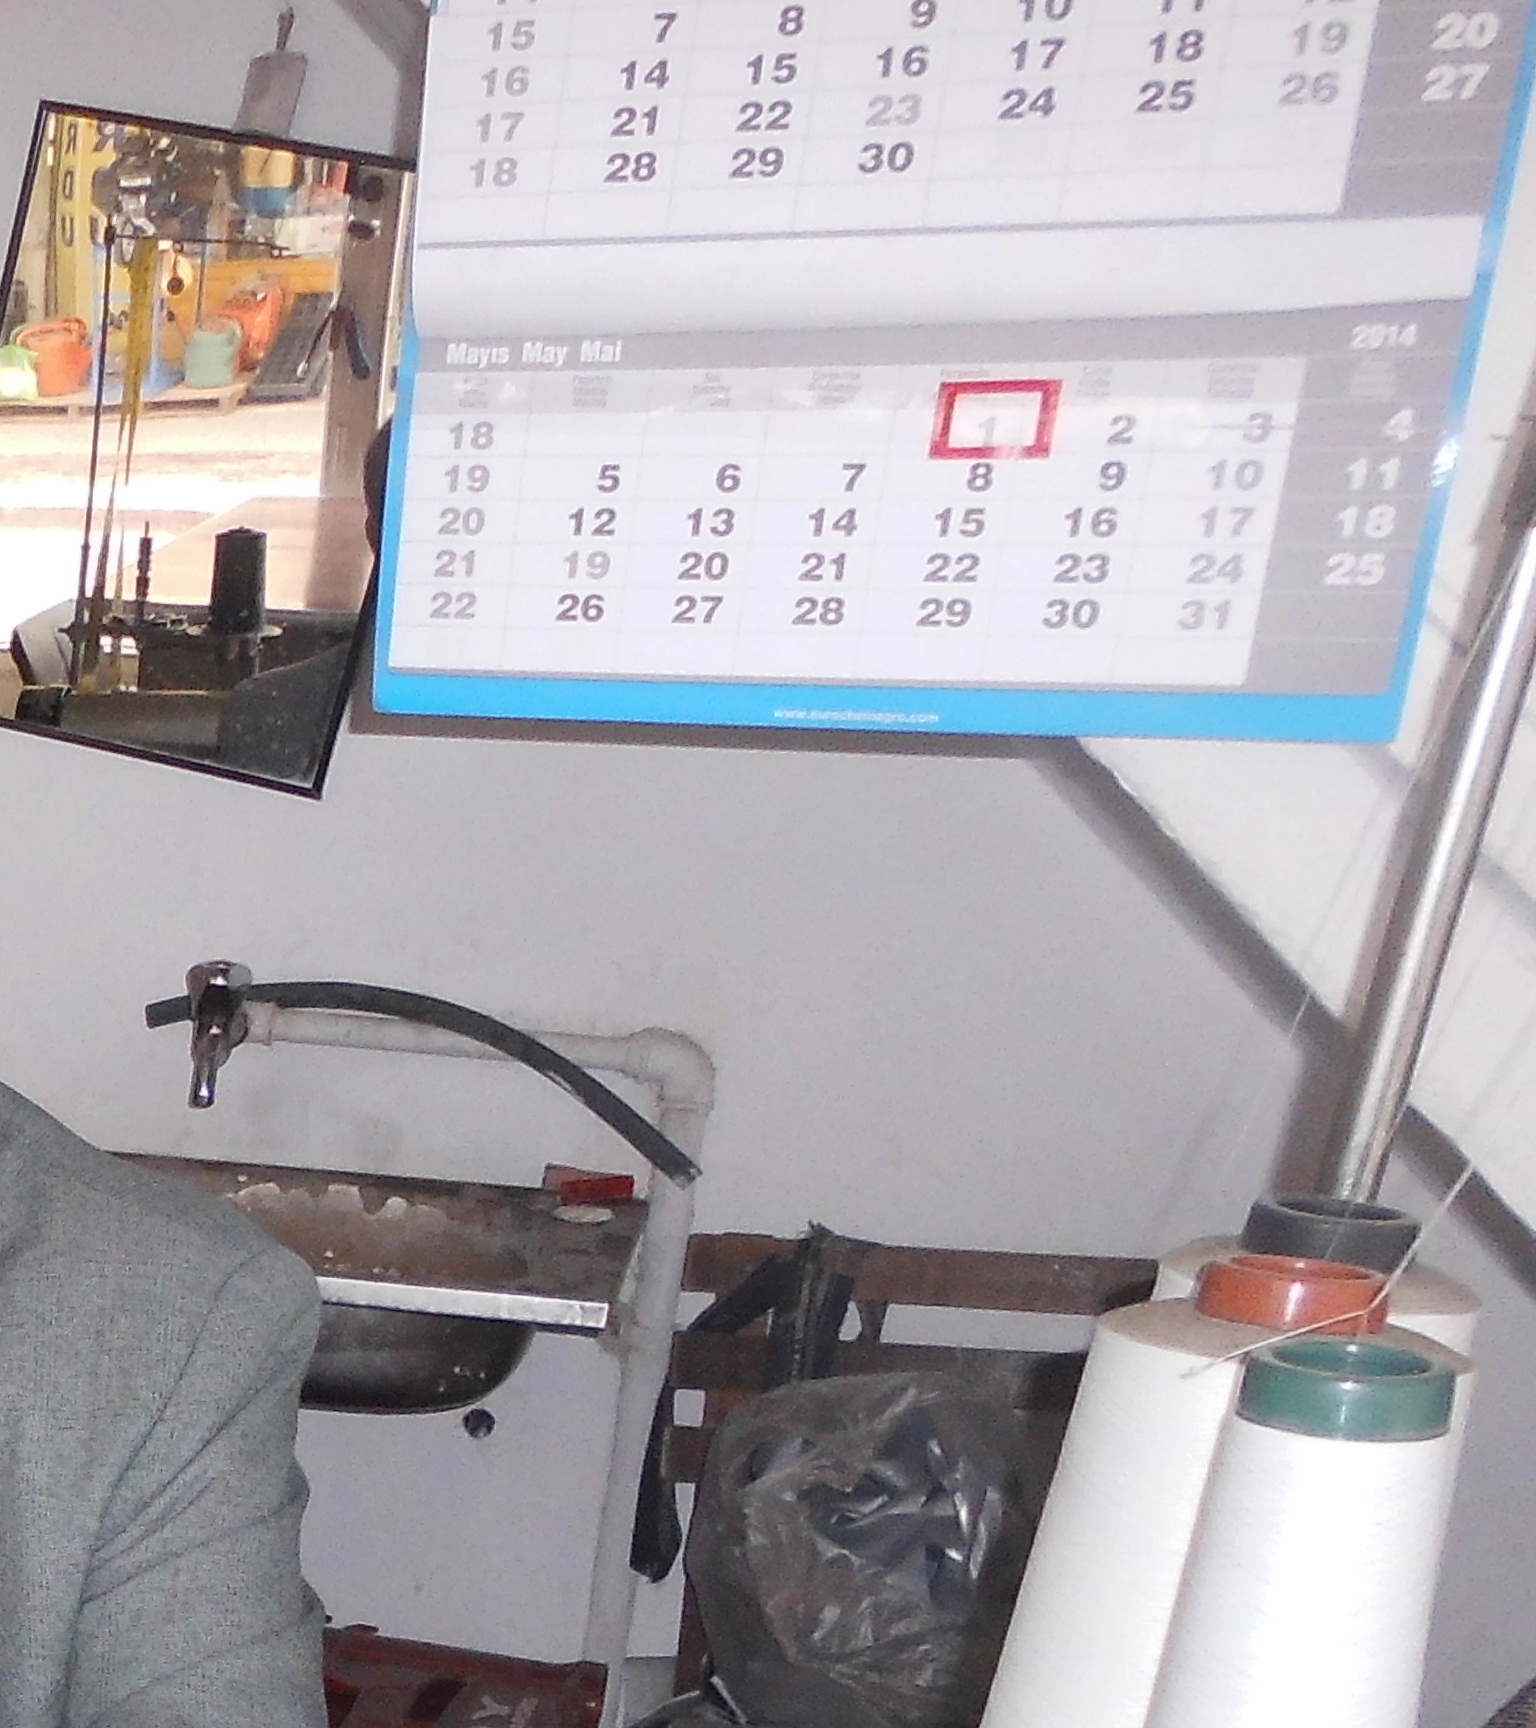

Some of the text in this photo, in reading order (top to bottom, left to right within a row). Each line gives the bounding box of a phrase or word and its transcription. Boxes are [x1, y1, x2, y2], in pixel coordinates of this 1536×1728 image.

[488, 19, 536, 52] 15
[654, 13, 678, 43] 7
[778, 4, 805, 36] 8
[910, 0, 937, 28] 9
[482, 12, 1498, 97] 16 14 15 16 17 18 19 20
[476, 64, 1491, 143] 17 21 22 23 24 25 26 27
[470, 142, 914, 188] 18 28 29 30
[522, 342, 567, 367] May
[580, 340, 622, 363] Mai
[1350, 323, 1418, 349] 2014
[449, 407, 1414, 452] 18 1 2 3 4
[444, 456, 1400, 494] 19 5 6 7 8 9 10 11
[437, 504, 1396, 539] 20 12 13 14 15 16 17 18
[434, 550, 1386, 586] 21 19 20 21 22 23 24 25
[430, 592, 1233, 631] 22 26 27 28 29 30 31
